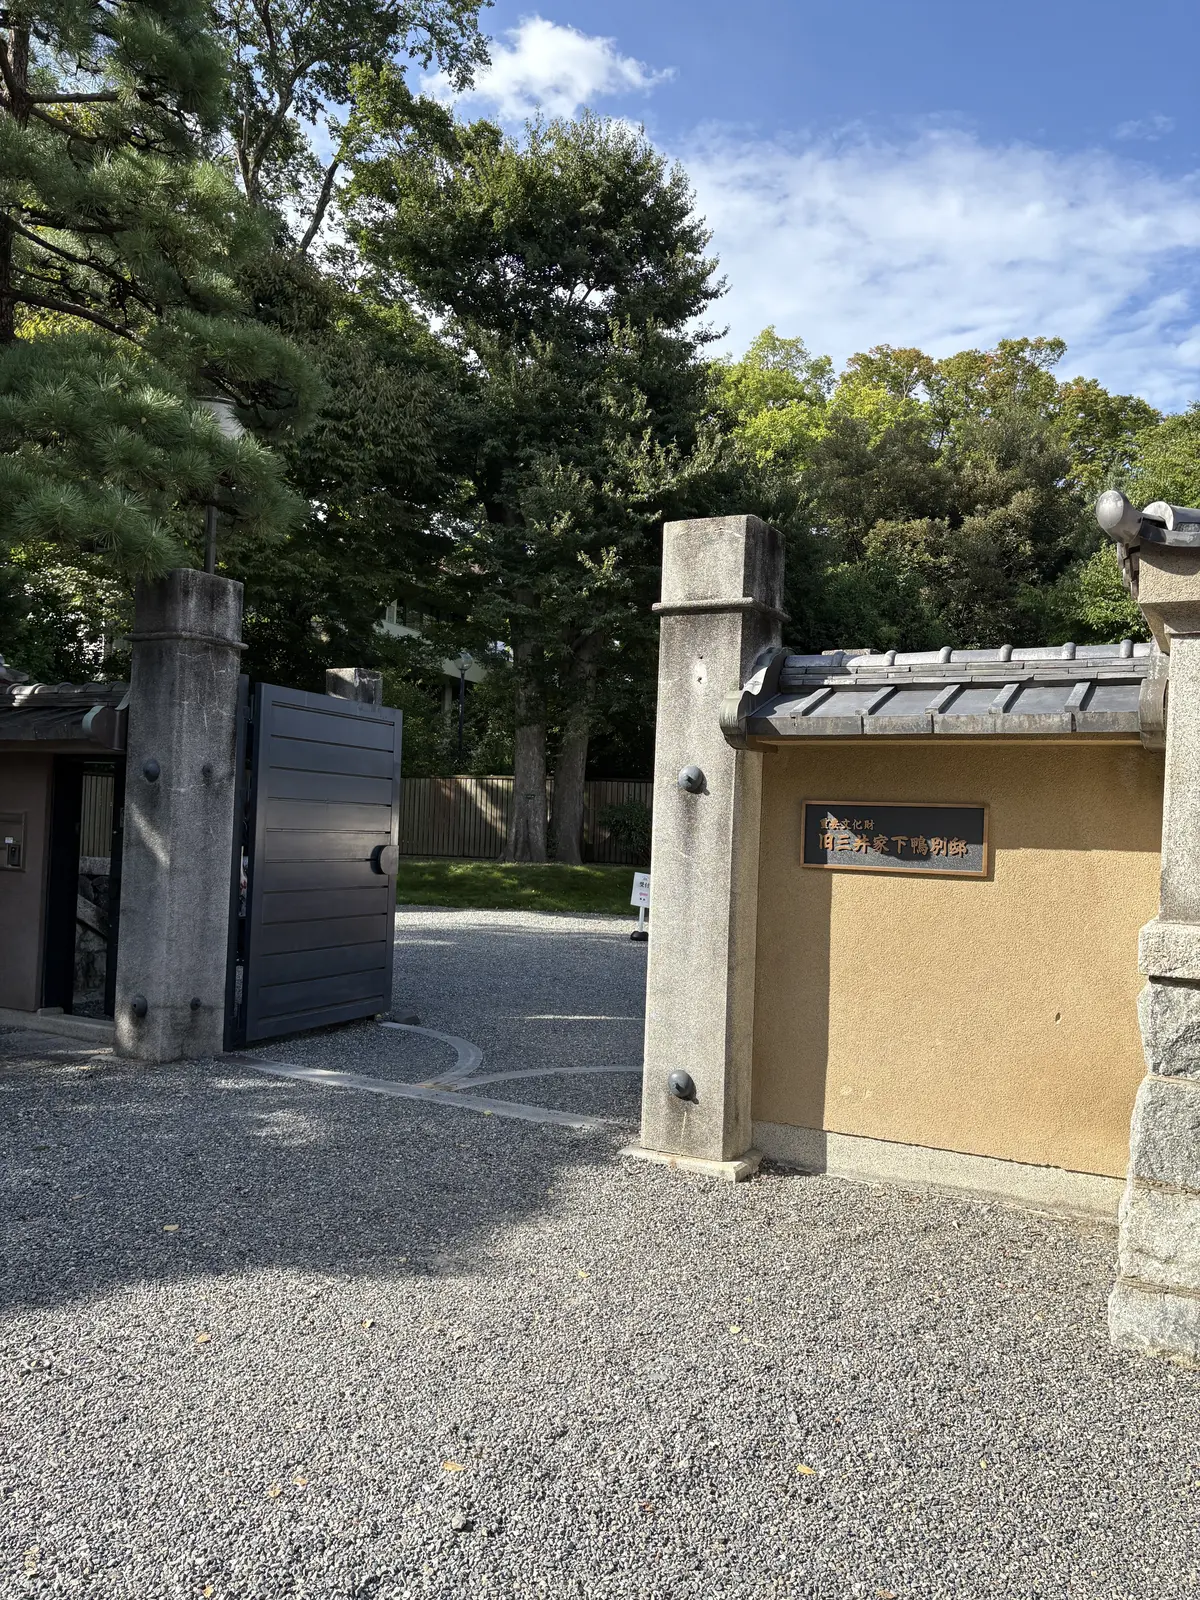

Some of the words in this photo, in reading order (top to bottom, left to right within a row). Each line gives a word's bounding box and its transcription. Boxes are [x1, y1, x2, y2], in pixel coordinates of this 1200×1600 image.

[819, 818, 875, 831] 重要文化財
[818, 833, 968, 857] 旧三井家下鴨別邸
